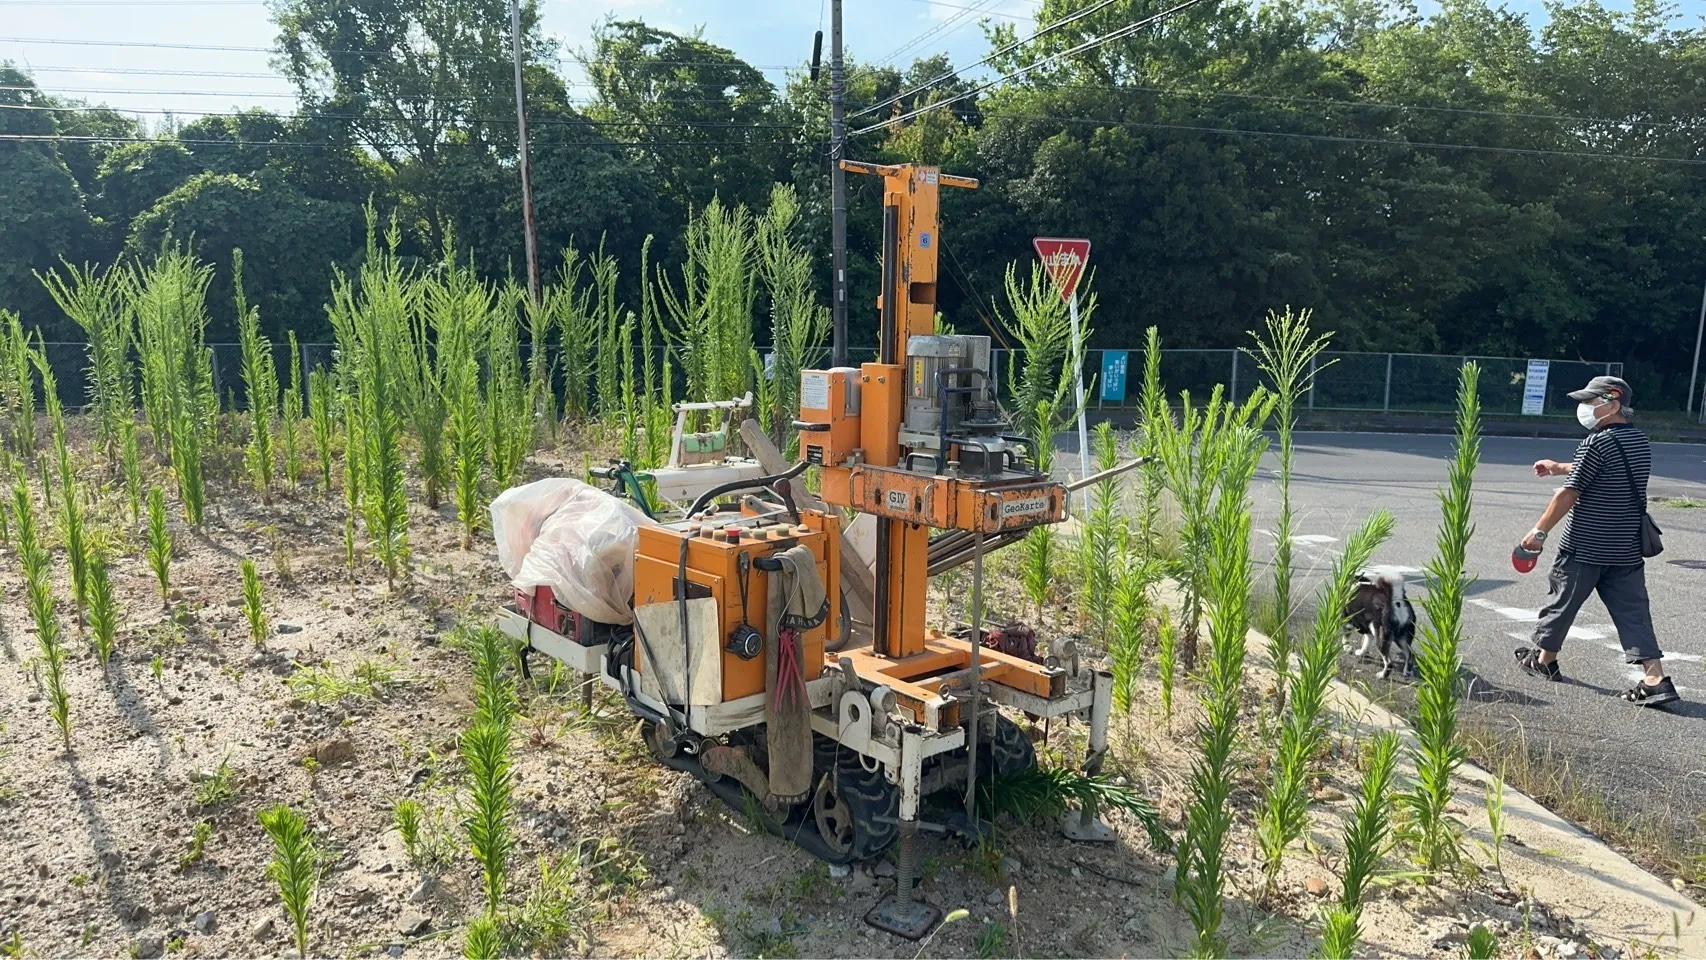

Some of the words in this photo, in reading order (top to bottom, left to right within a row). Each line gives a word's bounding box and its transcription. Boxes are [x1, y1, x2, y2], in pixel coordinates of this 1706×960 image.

[1048, 252, 1082, 267] 止まれ
[1004, 501, 1046, 513] GeoKarte
